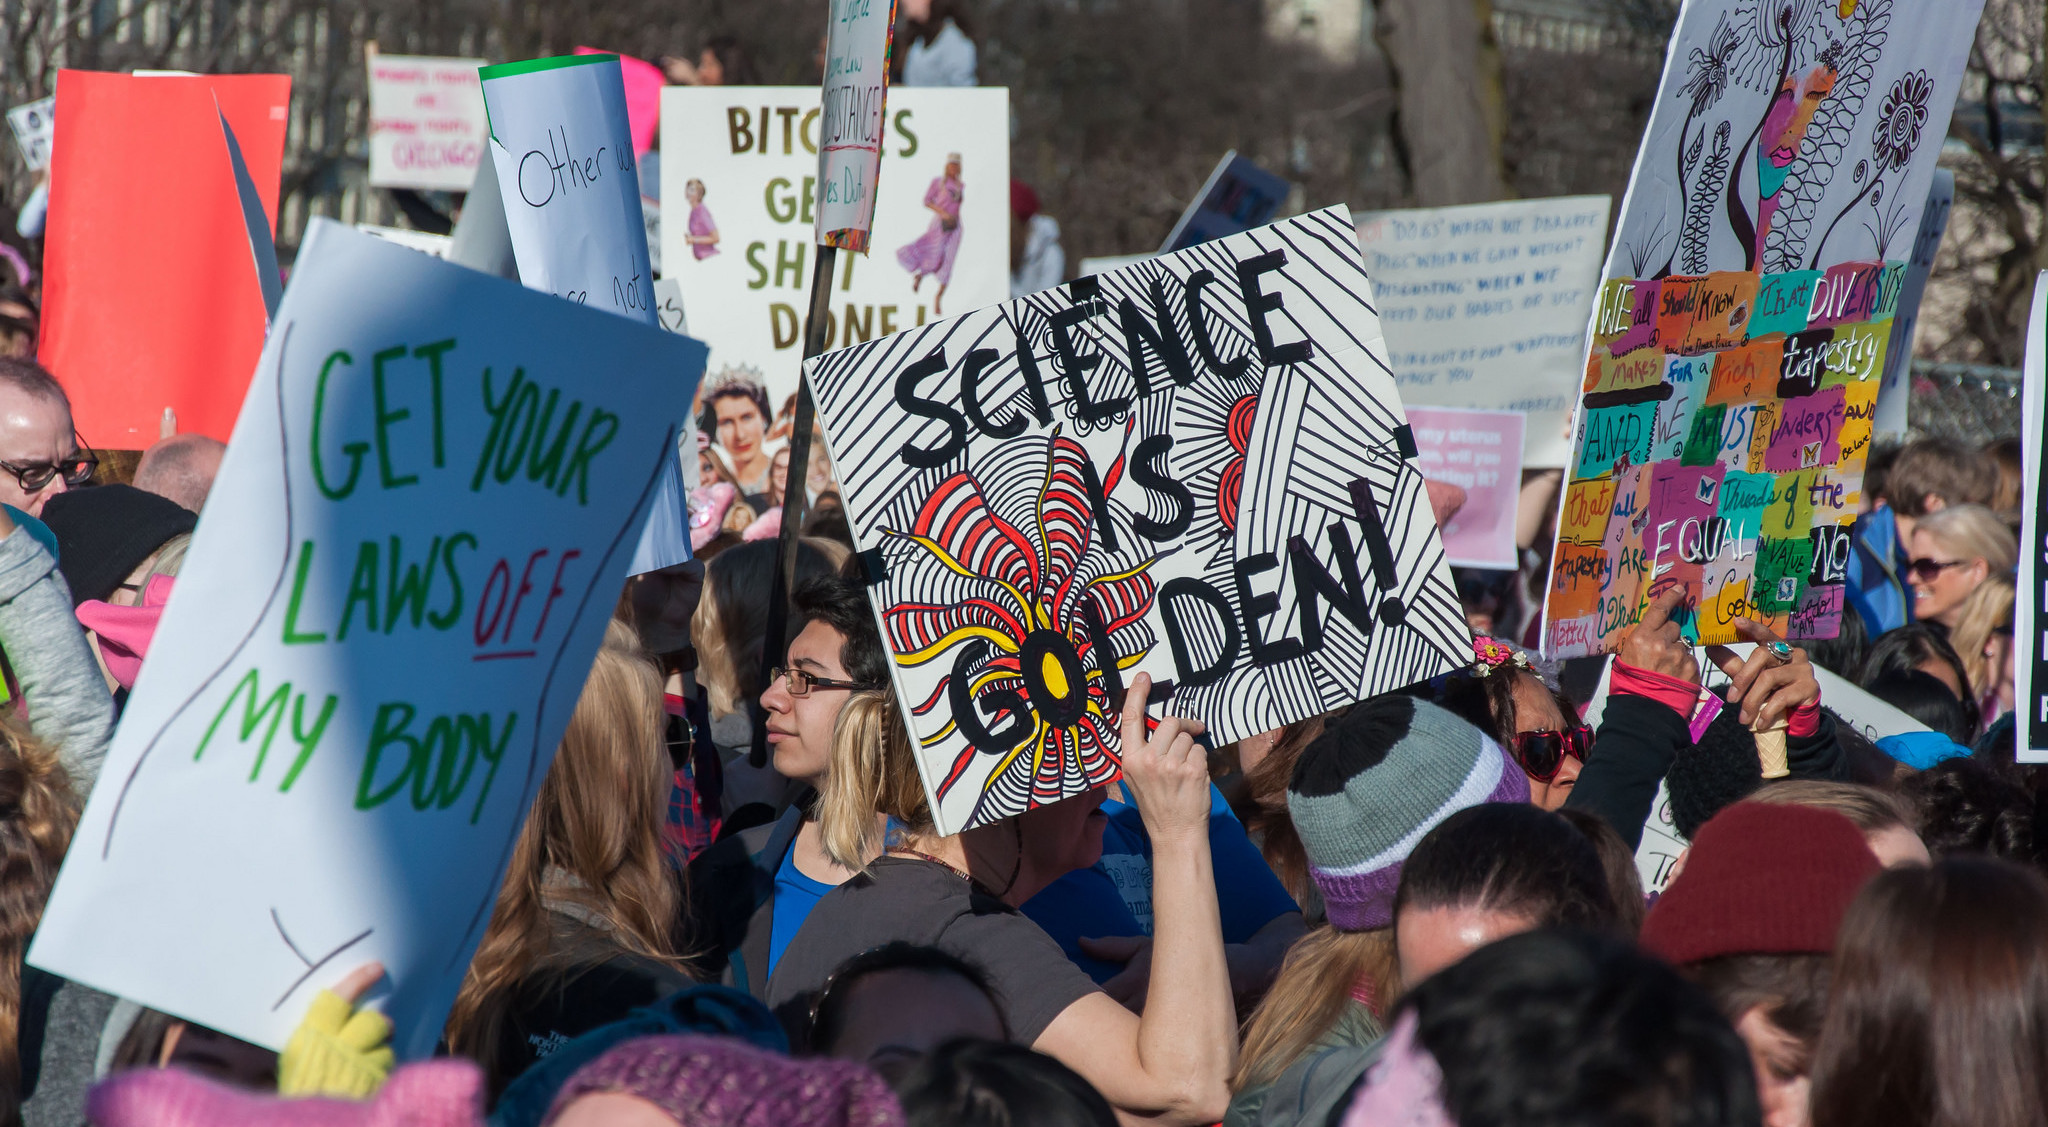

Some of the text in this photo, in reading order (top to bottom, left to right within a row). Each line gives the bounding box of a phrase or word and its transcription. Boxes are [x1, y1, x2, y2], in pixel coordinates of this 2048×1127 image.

[518, 124, 606, 208] Other
[844, 165, 868, 226] Duty
[1449, 218, 1494, 238] WHEN
[612, 253, 648, 314] not
[1477, 270, 1526, 294] WHEN
[1533, 265, 1561, 284] WE
[1600, 282, 1636, 336] WE
[1633, 290, 1656, 326] all
[1806, 264, 1906, 323] DIVERSITY
[1422, 304, 1458, 323] OUR
[894, 248, 1313, 470] SCIENCE
[1448, 367, 1476, 384] YOU
[1699, 361, 1709, 376] a
[1717, 351, 1756, 385] rich
[1783, 326, 1882, 389] tapestry
[309, 338, 619, 507] GET YOUR
[1417, 427, 1503, 446] my uterus
[1582, 411, 1642, 467] AND
[1656, 395, 1689, 445] WE
[1691, 403, 1767, 454] MUST
[1447, 449, 1472, 464] will
[1474, 453, 1500, 468] you
[1081, 433, 1196, 554] IS
[1569, 480, 1610, 528] that
[1614, 490, 1638, 518] all
[1784, 474, 1800, 530] of
[1808, 473, 1844, 511] the
[1555, 546, 1613, 593] tapestry
[1650, 514, 1753, 581] EQUAL
[1810, 519, 1851, 582] NO
[282, 531, 582, 648] LAWS OFF
[948, 475, 1406, 757] GOLDEN!
[193, 667, 518, 826] MY BODY
